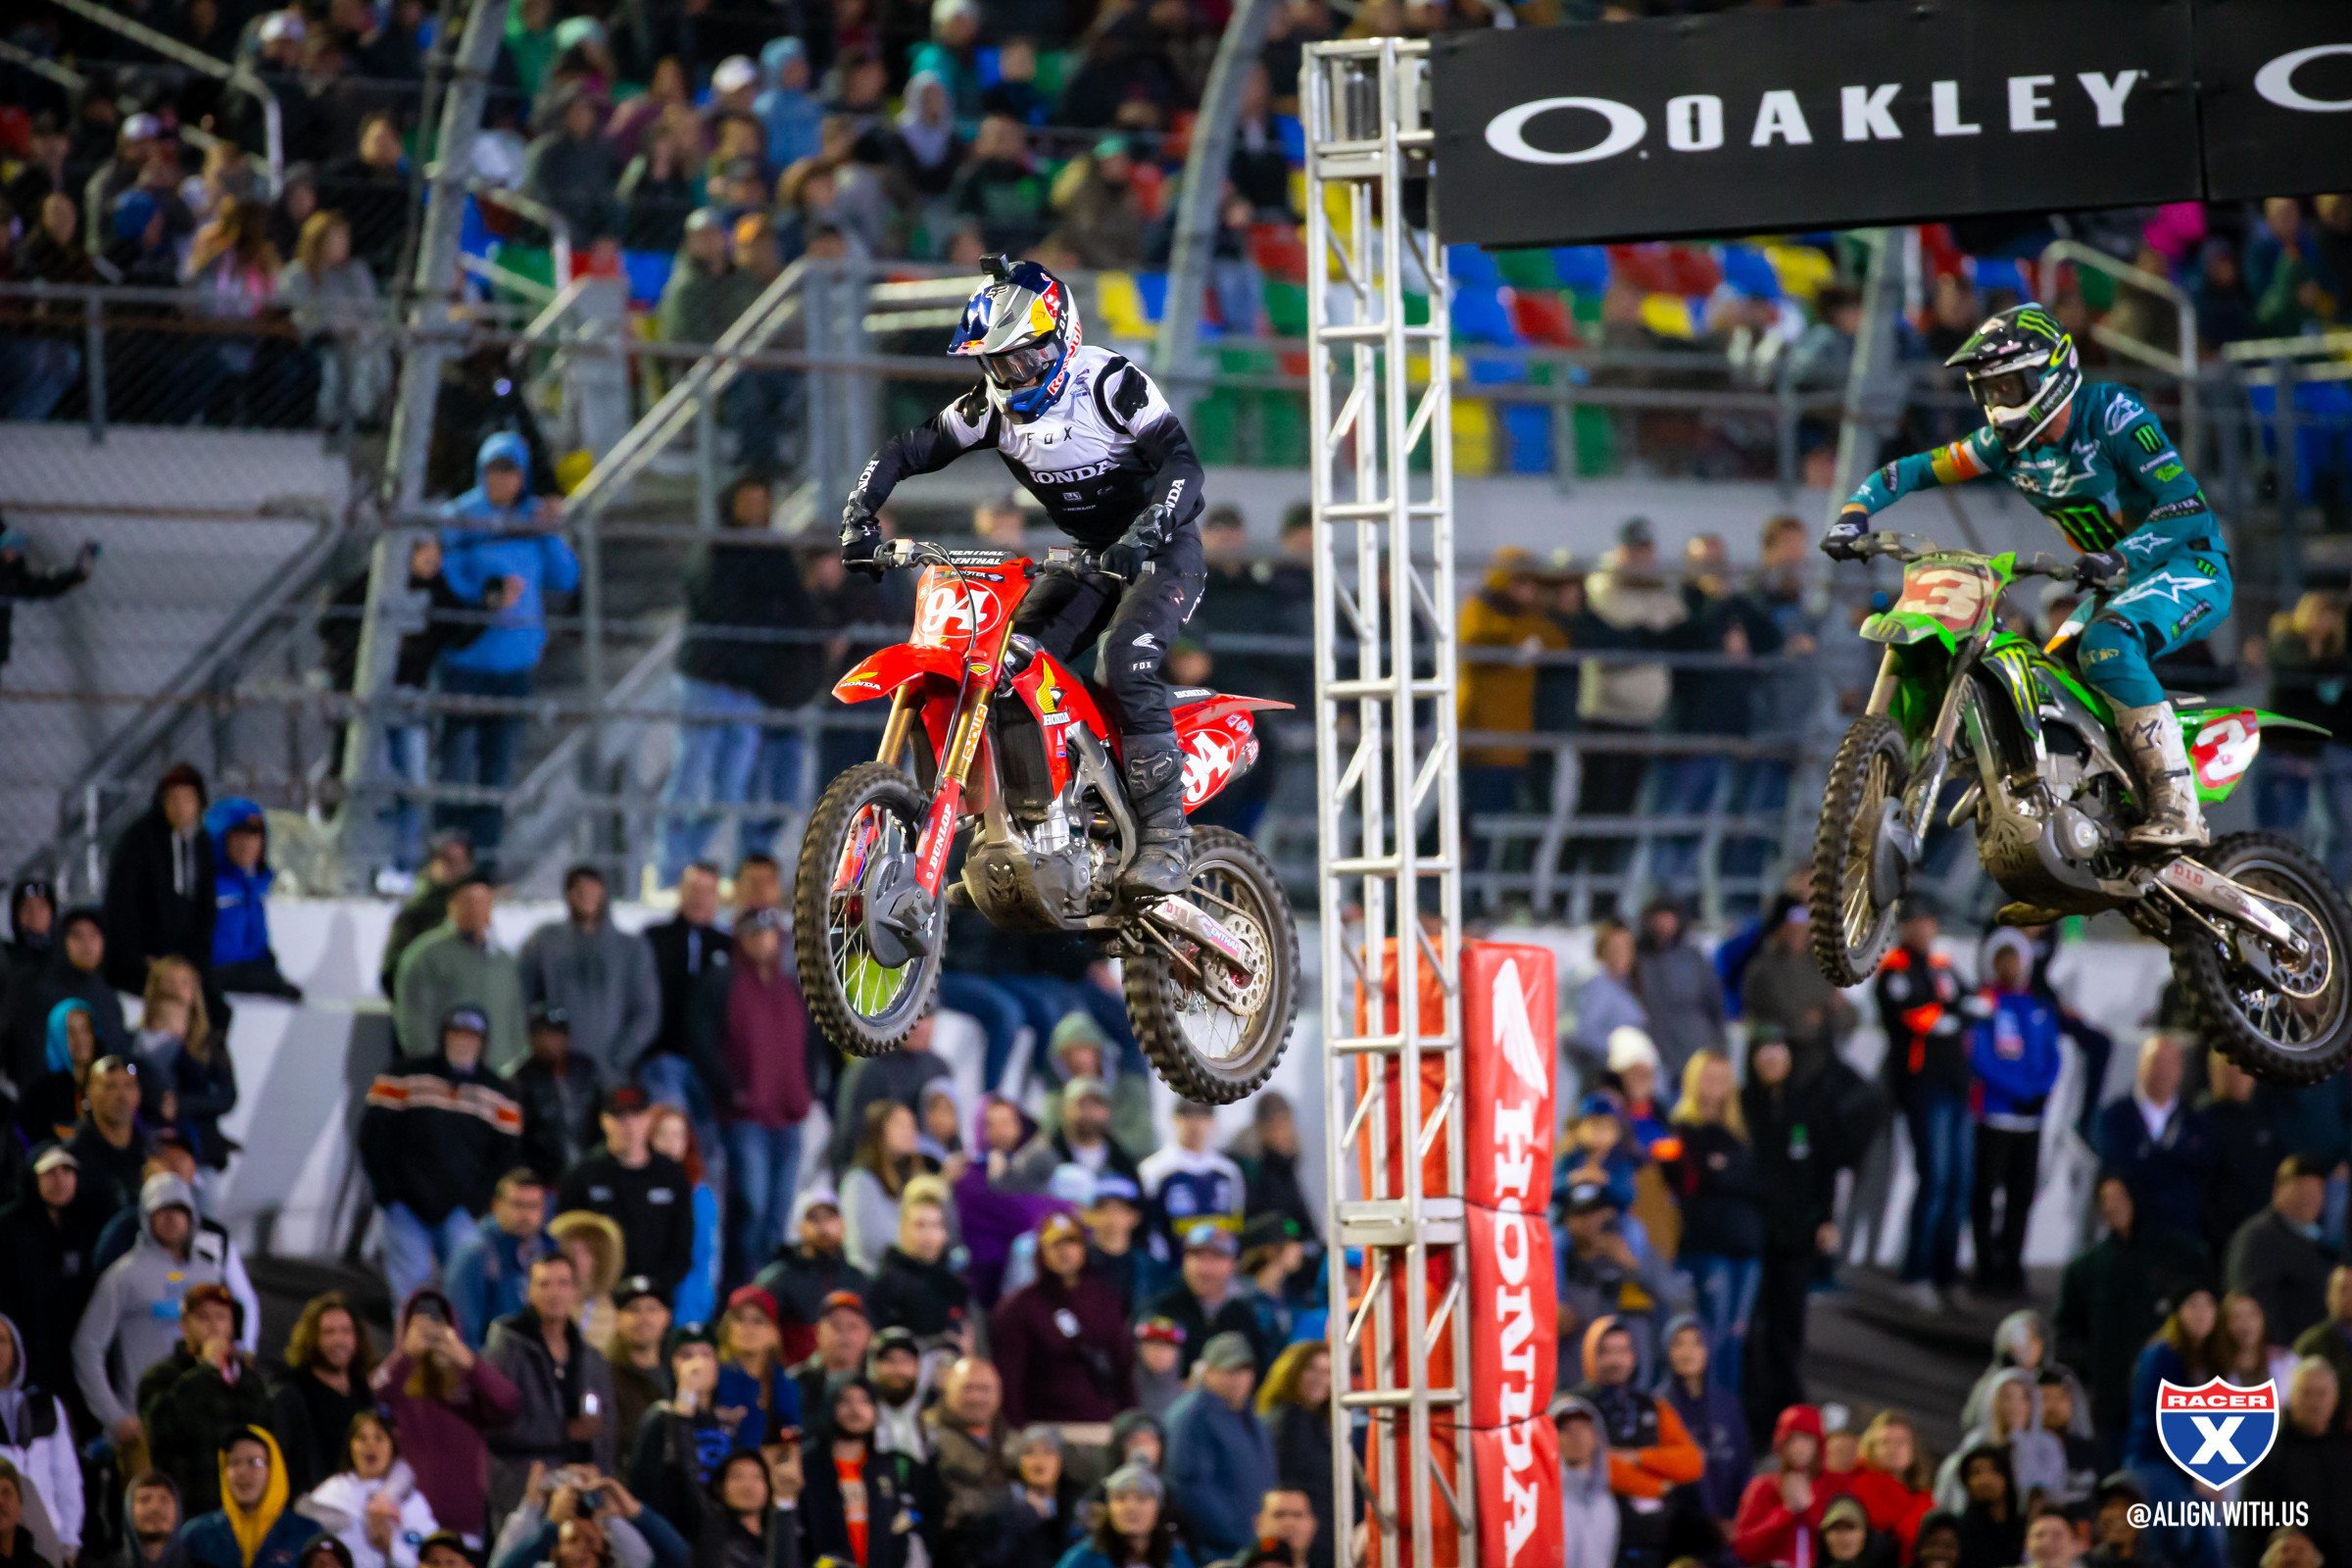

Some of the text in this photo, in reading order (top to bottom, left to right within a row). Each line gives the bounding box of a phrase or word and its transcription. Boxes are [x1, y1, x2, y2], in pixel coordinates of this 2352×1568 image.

[1666, 70, 2139, 152] OAKLEY
[1056, 309, 1068, 339] FOX
[1027, 426, 1073, 446] FOX
[858, 460, 880, 492] HON
[1165, 478, 1186, 517] NDA
[922, 588, 990, 633] 94
[1903, 569, 1993, 621] 3
[839, 681, 881, 690] HONDA
[1133, 662, 1152, 671] FOX
[1173, 689, 1211, 699] HONDA
[963, 705, 988, 760] SHOWA
[1043, 711, 1070, 726] HONDA
[1180, 731, 1232, 803] 94
[2195, 718, 2253, 781] 3
[929, 803, 953, 869] DUNLOP
[2174, 862, 2204, 886] DID
[1494, 1099, 1539, 1568] HONDA
